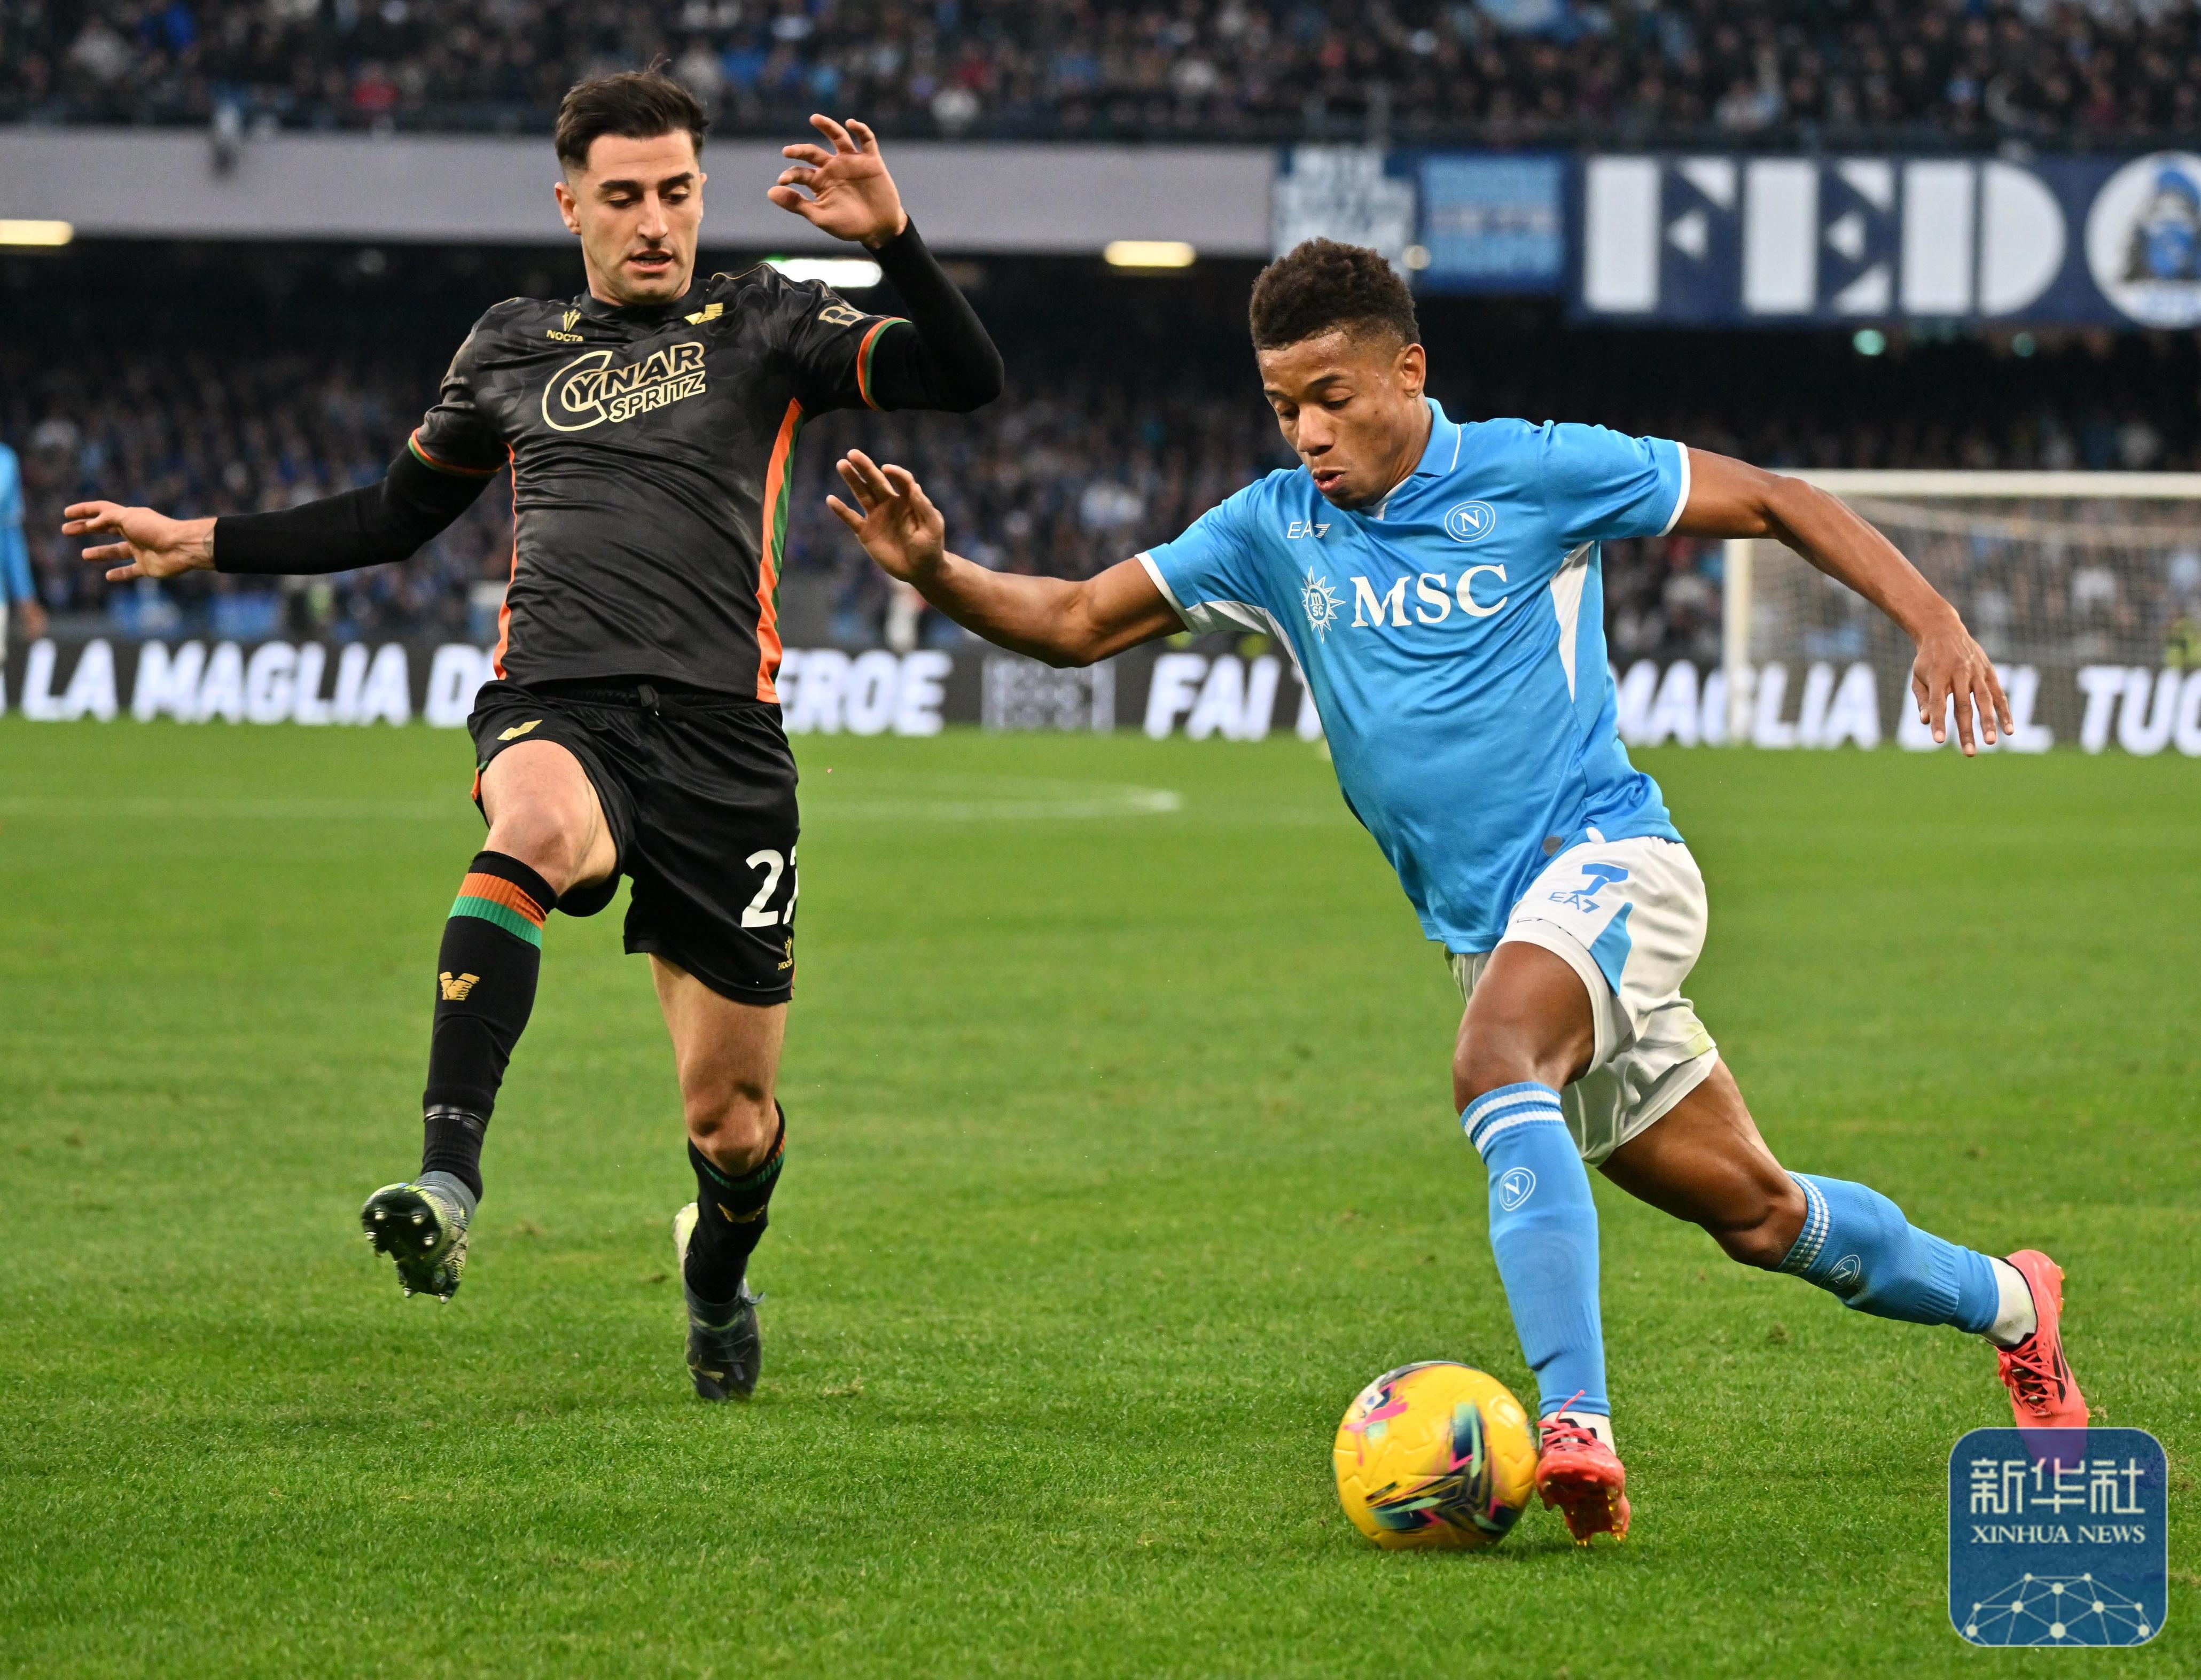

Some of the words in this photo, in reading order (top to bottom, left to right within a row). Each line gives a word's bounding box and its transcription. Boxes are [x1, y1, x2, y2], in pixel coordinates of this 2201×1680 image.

[547, 330, 583, 342] NOCTA
[542, 341, 706, 432] CYNAR
[608, 370, 706, 423] SPRITZ
[1287, 520, 1331, 539] EA7
[1458, 510, 1480, 532] N
[1349, 564, 1508, 628] MSC
[21, 638, 118, 722] LA
[131, 640, 411, 727] MAGLIA
[1143, 653, 1280, 741] FAI
[1548, 892, 1600, 913] EA7
[1504, 1176, 1520, 1202] N
